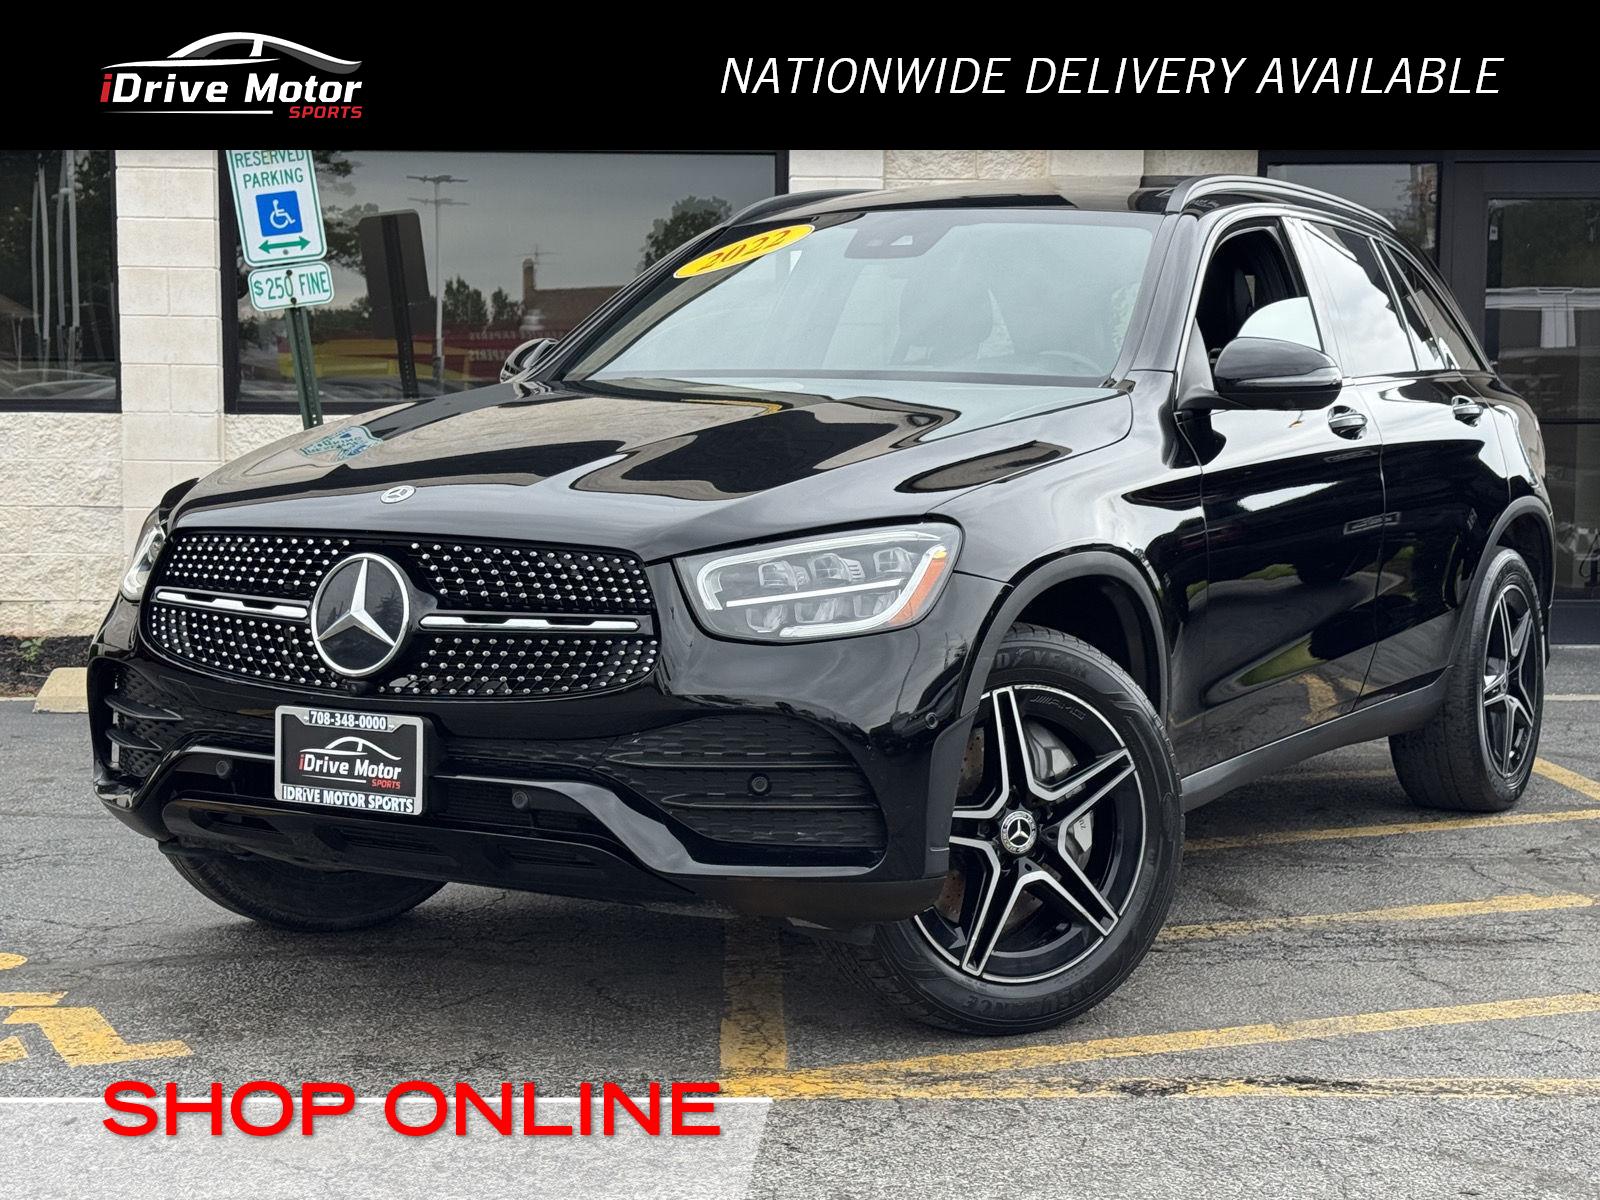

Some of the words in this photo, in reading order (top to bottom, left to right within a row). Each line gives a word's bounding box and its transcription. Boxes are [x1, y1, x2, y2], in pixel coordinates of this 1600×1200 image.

[234, 150, 305, 168] RESERVED
[242, 168, 304, 189] PARKING
[696, 229, 792, 272] 2022
[253, 275, 294, 300] $250
[299, 271, 330, 297] FINE
[310, 711, 387, 730] 708-348-0000
[299, 754, 350, 775] iDrive
[354, 758, 402, 780] Motor
[371, 778, 401, 790] SPORTS
[323, 789, 366, 808] MOTOR
[368, 796, 414, 813] SPORTS
